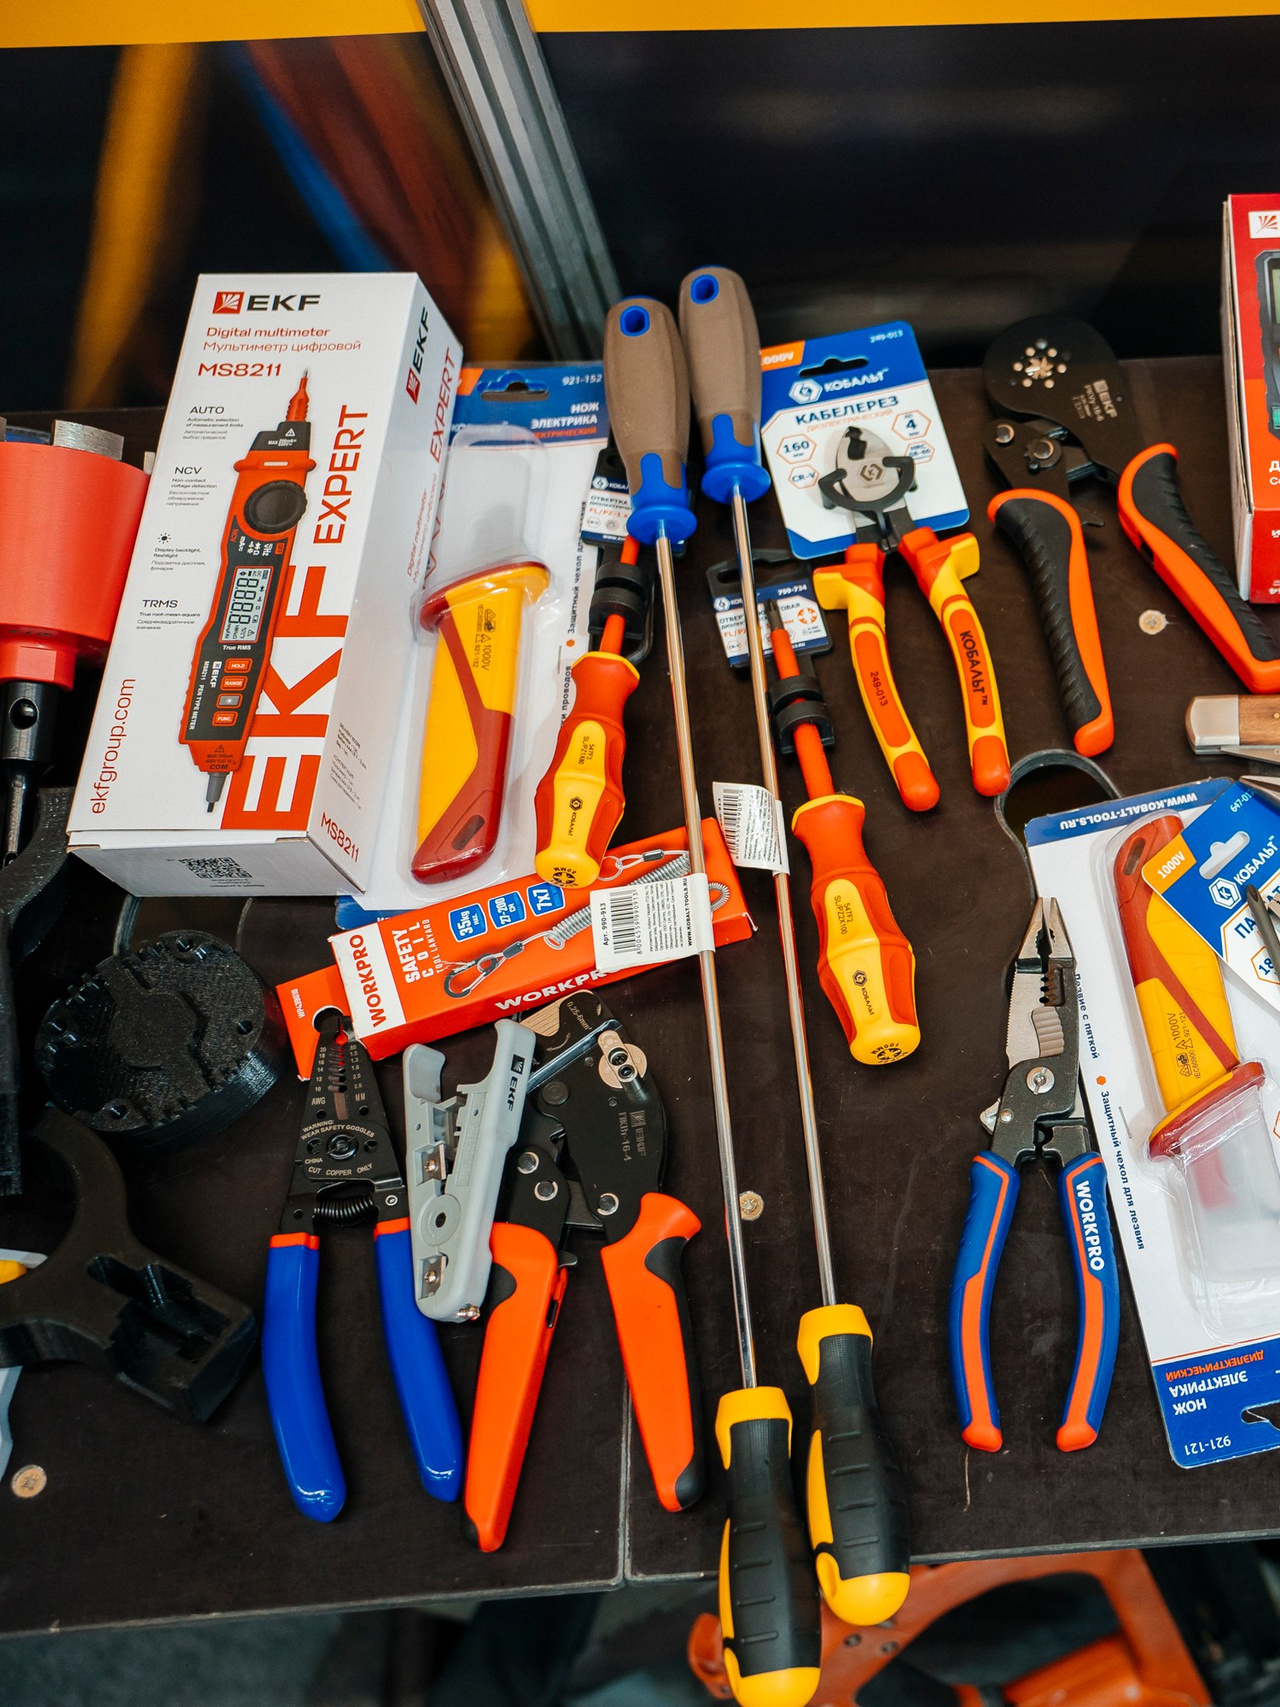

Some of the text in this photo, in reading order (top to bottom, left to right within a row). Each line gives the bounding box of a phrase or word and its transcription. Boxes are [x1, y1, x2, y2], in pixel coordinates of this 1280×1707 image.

[247, 295, 321, 311] EKF
[206, 327, 330, 338] Digital multimeter
[411, 306, 430, 373] EKF
[203, 341, 361, 353] Мультиметр цифровой
[198, 364, 281, 377] MS8211
[562, 374, 602, 386] 921-152
[190, 406, 224, 414] AUTO
[430, 347, 454, 464] EXPERT
[571, 402, 599, 414] НОЖ
[795, 396, 899, 425] КАБЕЛЕРЕЗ
[1100, 392, 1118, 418] EKF
[531, 416, 597, 429] ЭЛЕКТРИКА
[906, 419, 916, 430] 4
[783, 441, 810, 454] 160
[313, 406, 368, 544] EXPERT
[792, 473, 816, 484] CR-V
[142, 600, 178, 608] TRMS
[482, 644, 491, 671] 1000V
[210, 669, 220, 688] EKF
[562, 665, 571, 710] проводов
[870, 671, 889, 706] 249-013
[221, 566, 350, 831] EKF
[189, 712, 199, 730] METER
[90, 679, 135, 814] ekfgroup.com
[1060, 792, 1198, 830] WWW.KOBALT-TOOLS.RU
[320, 812, 360, 863] MS8211
[1157, 850, 1186, 880] 1000V
[494, 898, 511, 925] 27-200
[532, 889, 552, 911] 7X7
[457, 910, 474, 936] 35kg
[392, 930, 421, 983] SAFETY
[422, 919, 444, 973] TOOL LANYARD
[349, 934, 387, 1028] WORKPRO
[496, 968, 621, 1012] WORKPR
[861, 987, 875, 1016] КОБАЛЬТ
[1166, 1012, 1182, 1041] 1000V
[1083, 1023, 1099, 1059] пяткой
[312, 1097, 326, 1105] AWG
[508, 1077, 518, 1111] EKF
[301, 1125, 375, 1140] WEAR SAFETY GOGGLES
[303, 1120, 334, 1132] WARNING:
[636, 1128, 646, 1156] EKF
[308, 1166, 322, 1174] CUT
[357, 1163, 373, 1173] ONLY
[1101, 1091, 1145, 1250] Защитный чехол для лезвия
[1076, 1180, 1105, 1271] WORKPRO
[1165, 1348, 1264, 1382] ДИЭЛЕКТРИЧЕСКИЙ
[1168, 1370, 1248, 1398] ЭЛЕКТРИКА
[1174, 1397, 1208, 1416] НОЖ
[1184, 1434, 1232, 1456] 921-121
